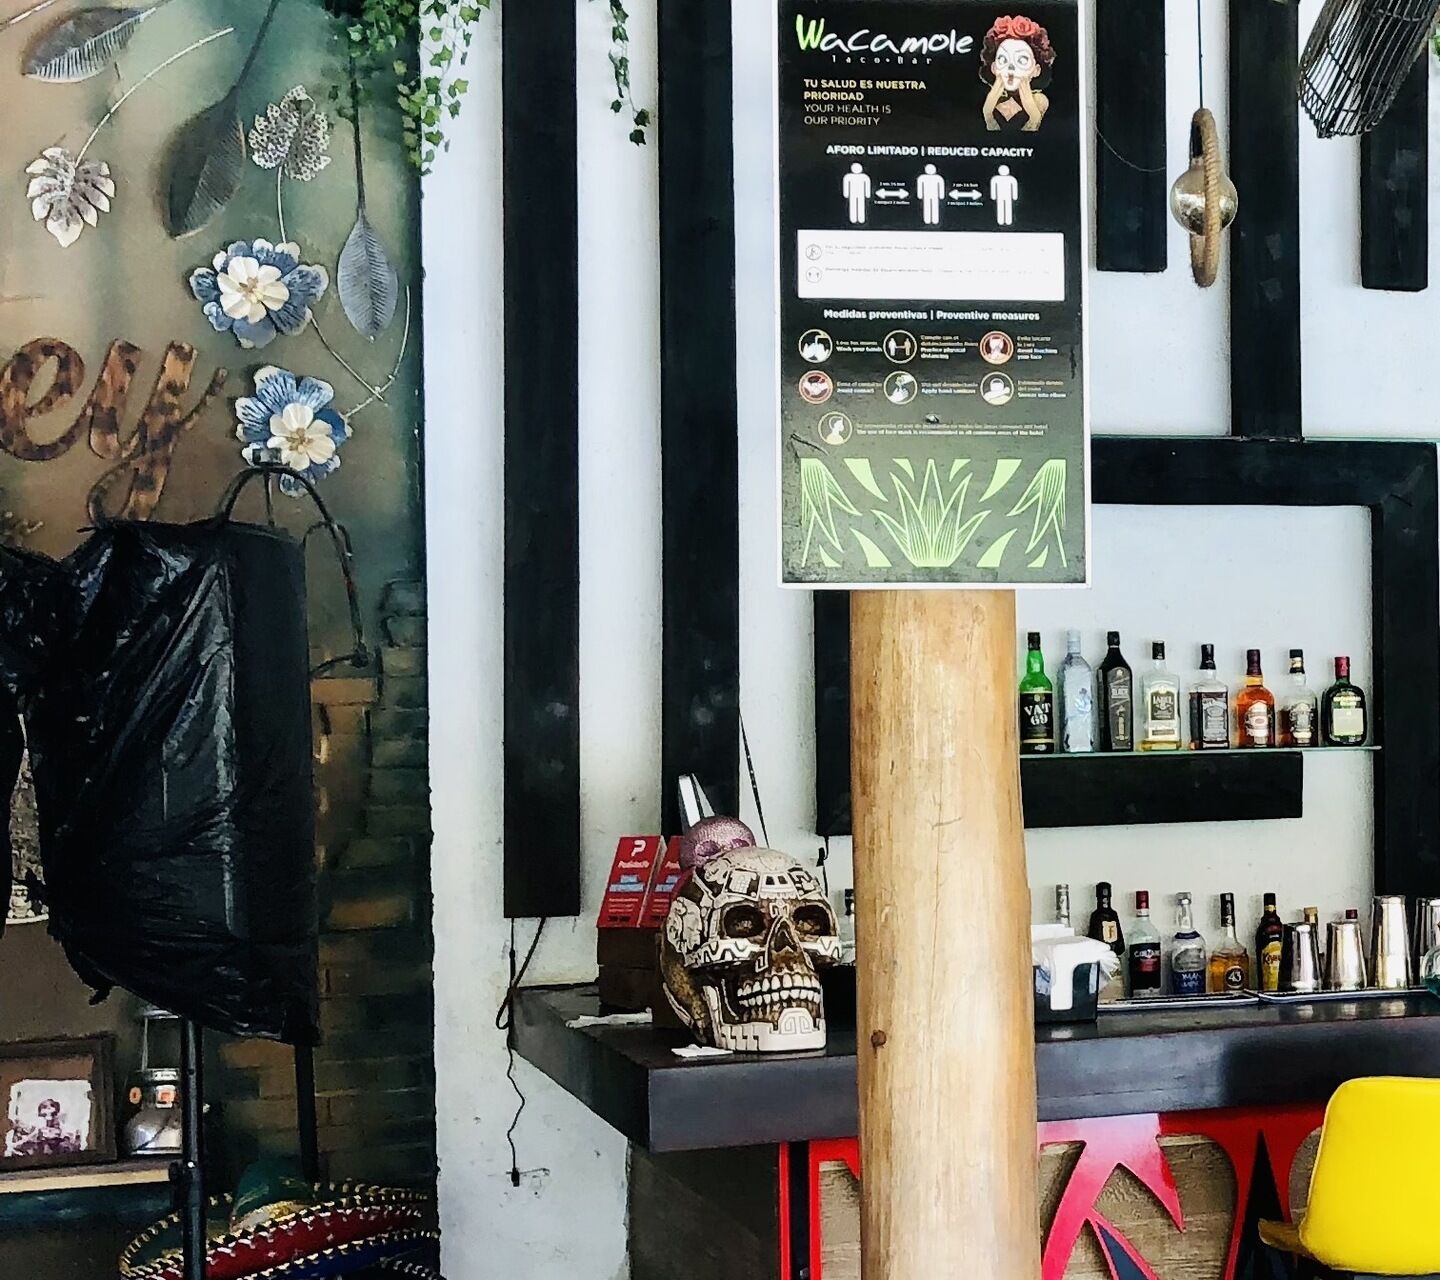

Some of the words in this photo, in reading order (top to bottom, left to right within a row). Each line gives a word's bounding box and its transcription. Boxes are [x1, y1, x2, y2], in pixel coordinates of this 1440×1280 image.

[795, 14, 974, 56] Wacamole
[803, 79, 818, 89] TU
[821, 79, 857, 89] SALUD
[860, 80, 873, 90] ES
[876, 80, 926, 90] NUESTRA
[803, 91, 864, 101] PRIORIDAD
[804, 103, 834, 113] YOUR
[837, 104, 879, 113] HEALTH
[882, 104, 892, 114] IS
[803, 116, 828, 125] OUR
[831, 116, 880, 126] PRIORITY
[826, 145, 865, 155] AFORO
[868, 146, 918, 156] LIMITADO
[927, 147, 979, 157] REDUCED
[981, 147, 1034, 158] CAPACITY
[823, 308, 867, 319] Medidas
[869, 310, 928, 321] preventivas
[936, 310, 989, 321] Preventive
[992, 312, 1040, 321] measures
[1024, 703, 1051, 717] VAT
[1227, 970, 1242, 983] 43
